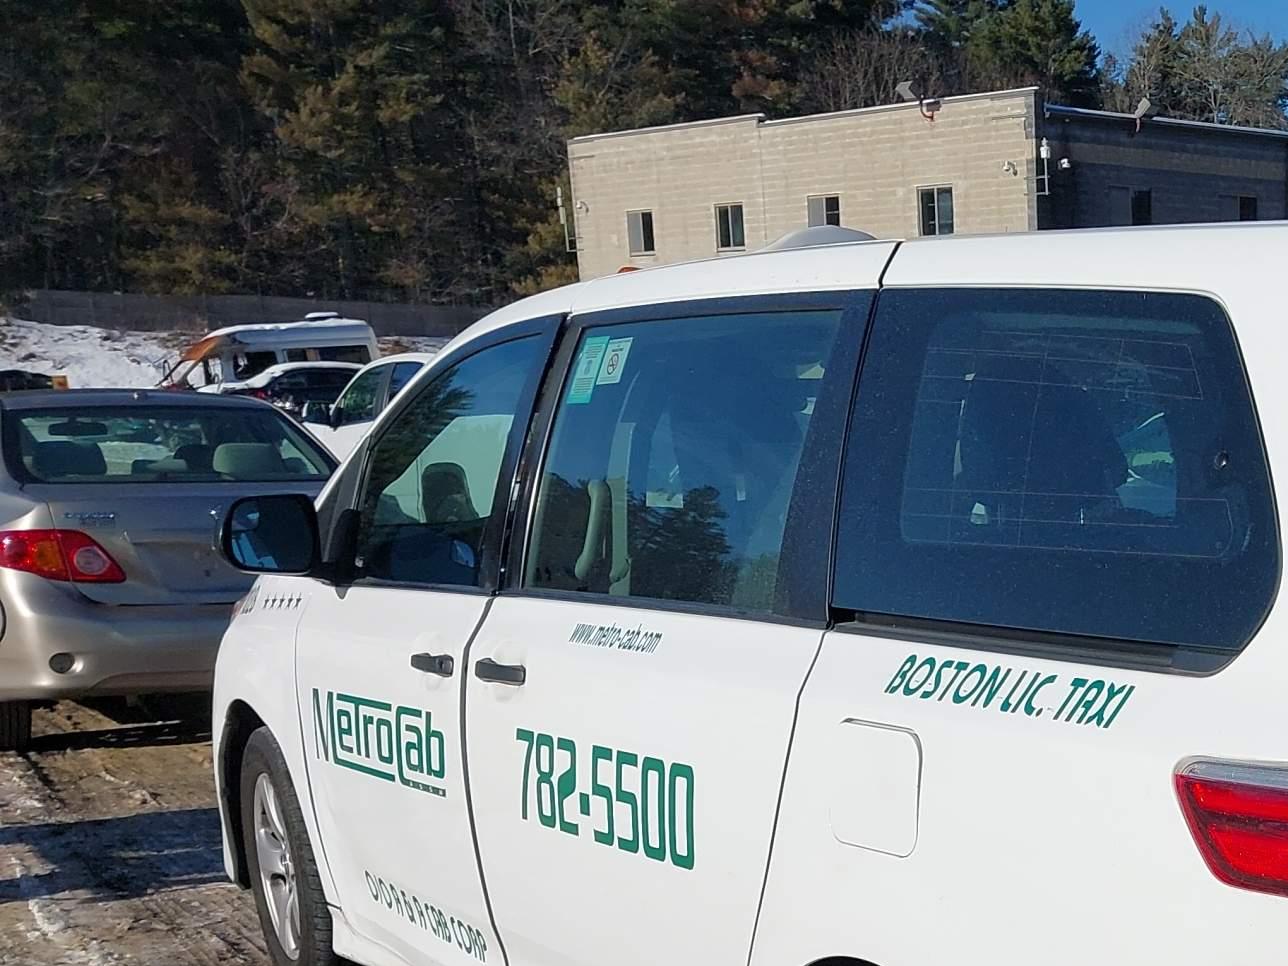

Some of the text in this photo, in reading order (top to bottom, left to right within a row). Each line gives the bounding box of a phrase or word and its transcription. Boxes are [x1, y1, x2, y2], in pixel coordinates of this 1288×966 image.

[568, 622, 662, 653] www.metro-cab.com
[884, 654, 1002, 709] BOSTON
[1052, 677, 1136, 728] TAXI
[516, 728, 695, 871] 782-5500
[424, 903, 452, 944] CAB
[449, 916, 488, 963] CORP
